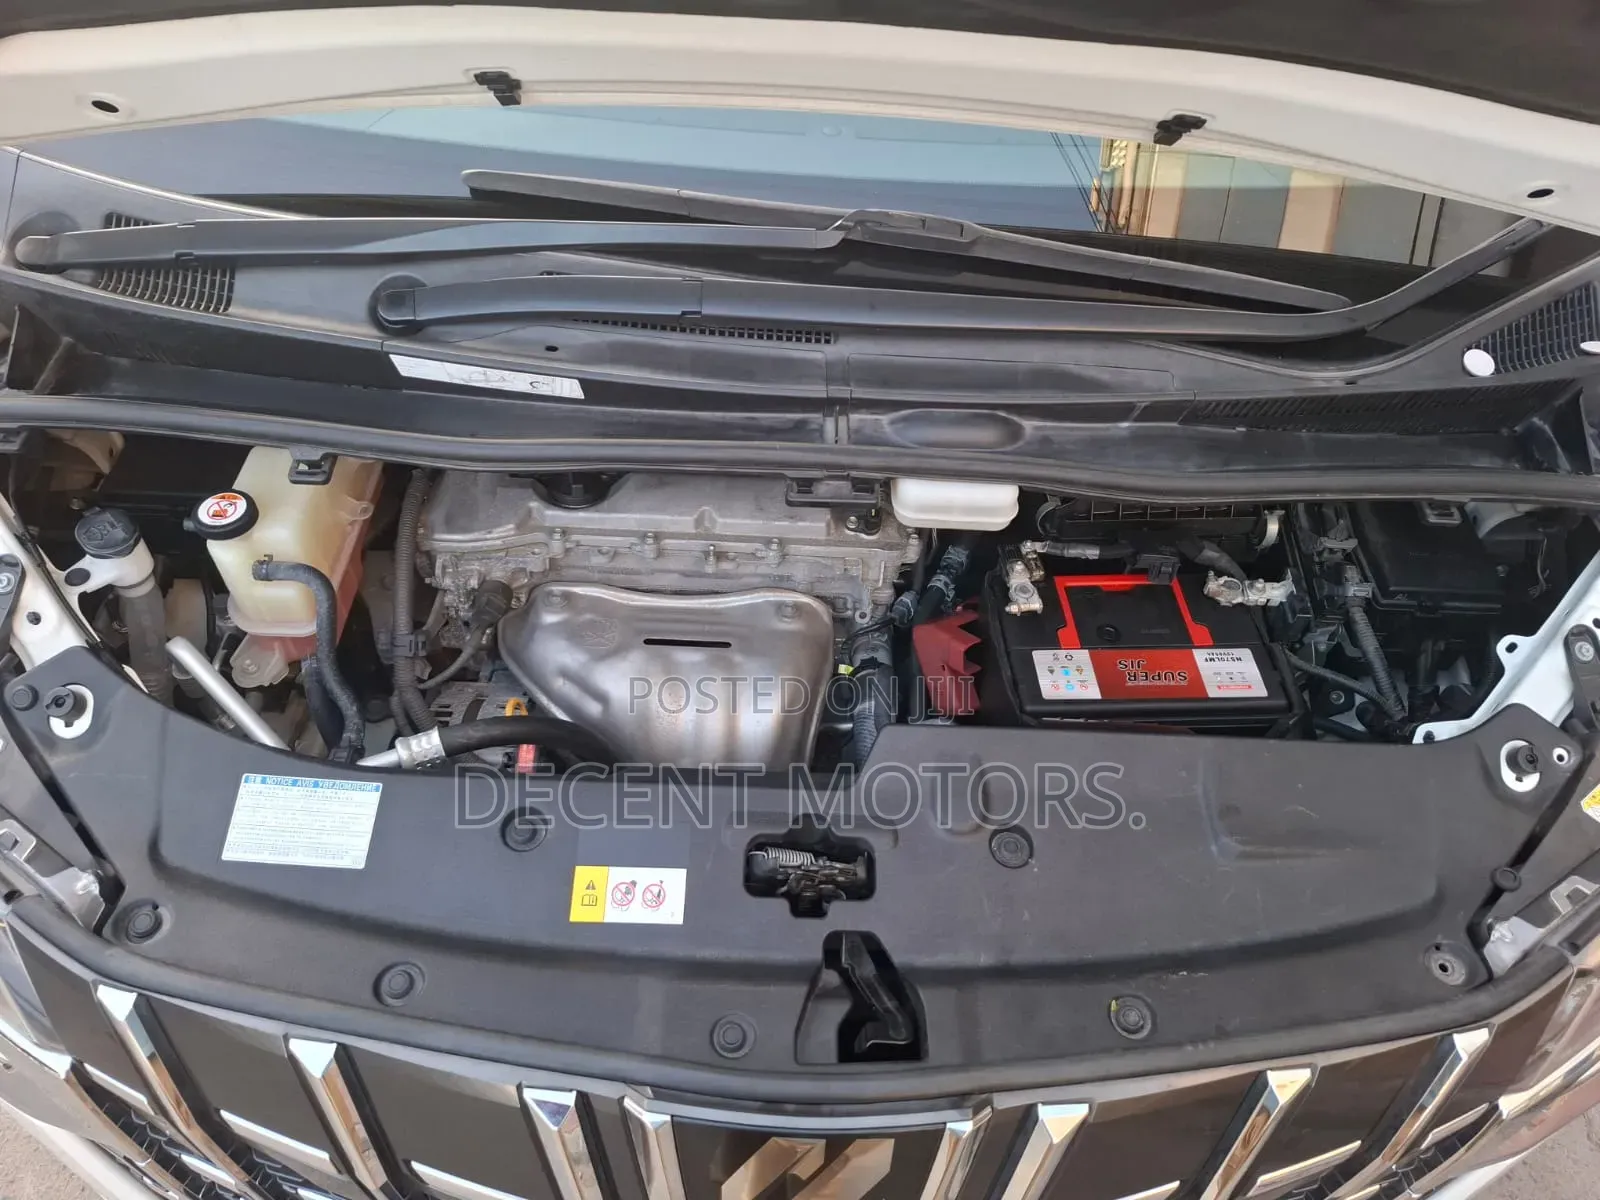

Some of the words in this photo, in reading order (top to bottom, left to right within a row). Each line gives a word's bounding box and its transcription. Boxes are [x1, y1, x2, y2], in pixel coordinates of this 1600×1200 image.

[1117, 658, 1146, 671] JIS
[1125, 670, 1188, 682] SUPER
[266, 776, 293, 786] NOTICE
[296, 779, 314, 787] AVIS
